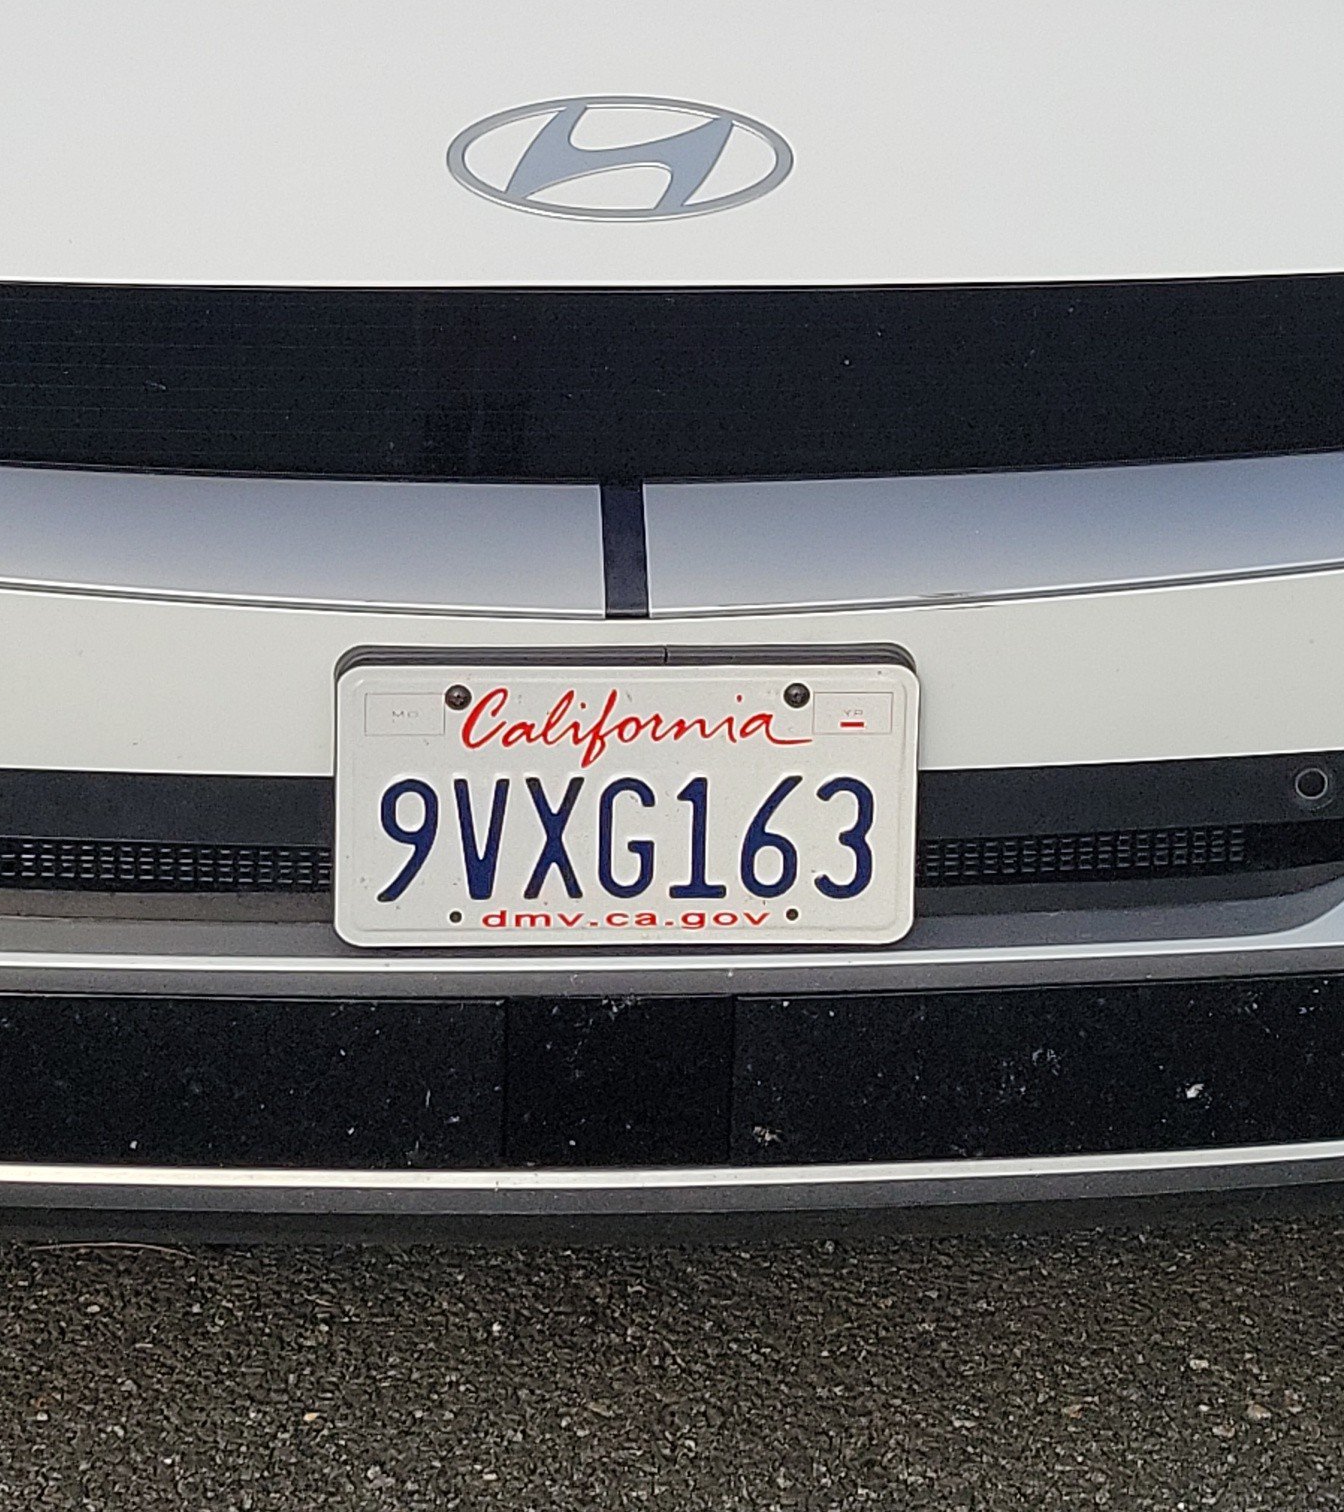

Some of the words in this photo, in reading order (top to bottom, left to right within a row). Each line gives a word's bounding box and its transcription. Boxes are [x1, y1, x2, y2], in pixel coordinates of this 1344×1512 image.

[460, 688, 813, 769] California
[376, 775, 875, 903] 9VXG163
[481, 909, 771, 929] dmv.ca.gov
